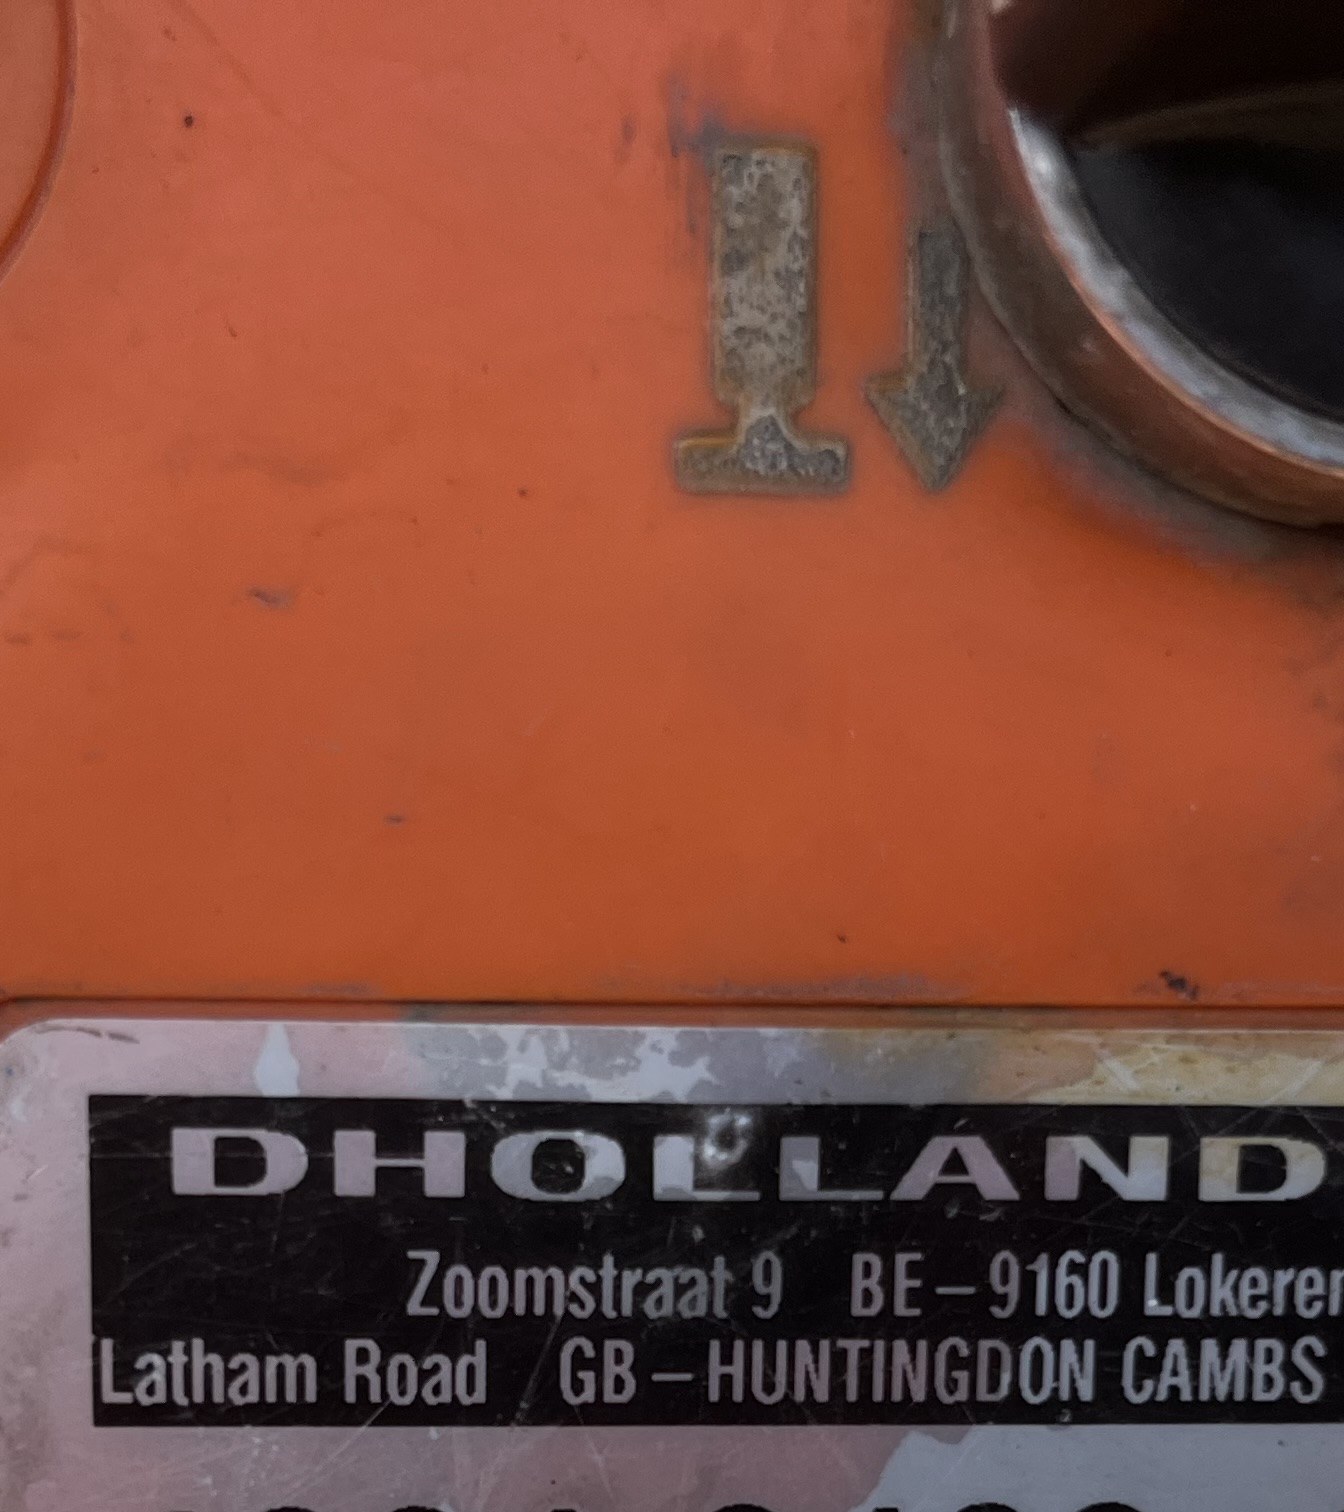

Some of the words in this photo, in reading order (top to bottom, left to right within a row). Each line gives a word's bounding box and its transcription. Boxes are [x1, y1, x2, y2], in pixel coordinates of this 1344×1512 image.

[405, 1249, 733, 1319] Zoomstraat
[750, 1250, 783, 1319] 9
[99, 1336, 318, 1405] Latham
[343, 1337, 488, 1406] Road
[1120, 1335, 1327, 1405] CAMBS
